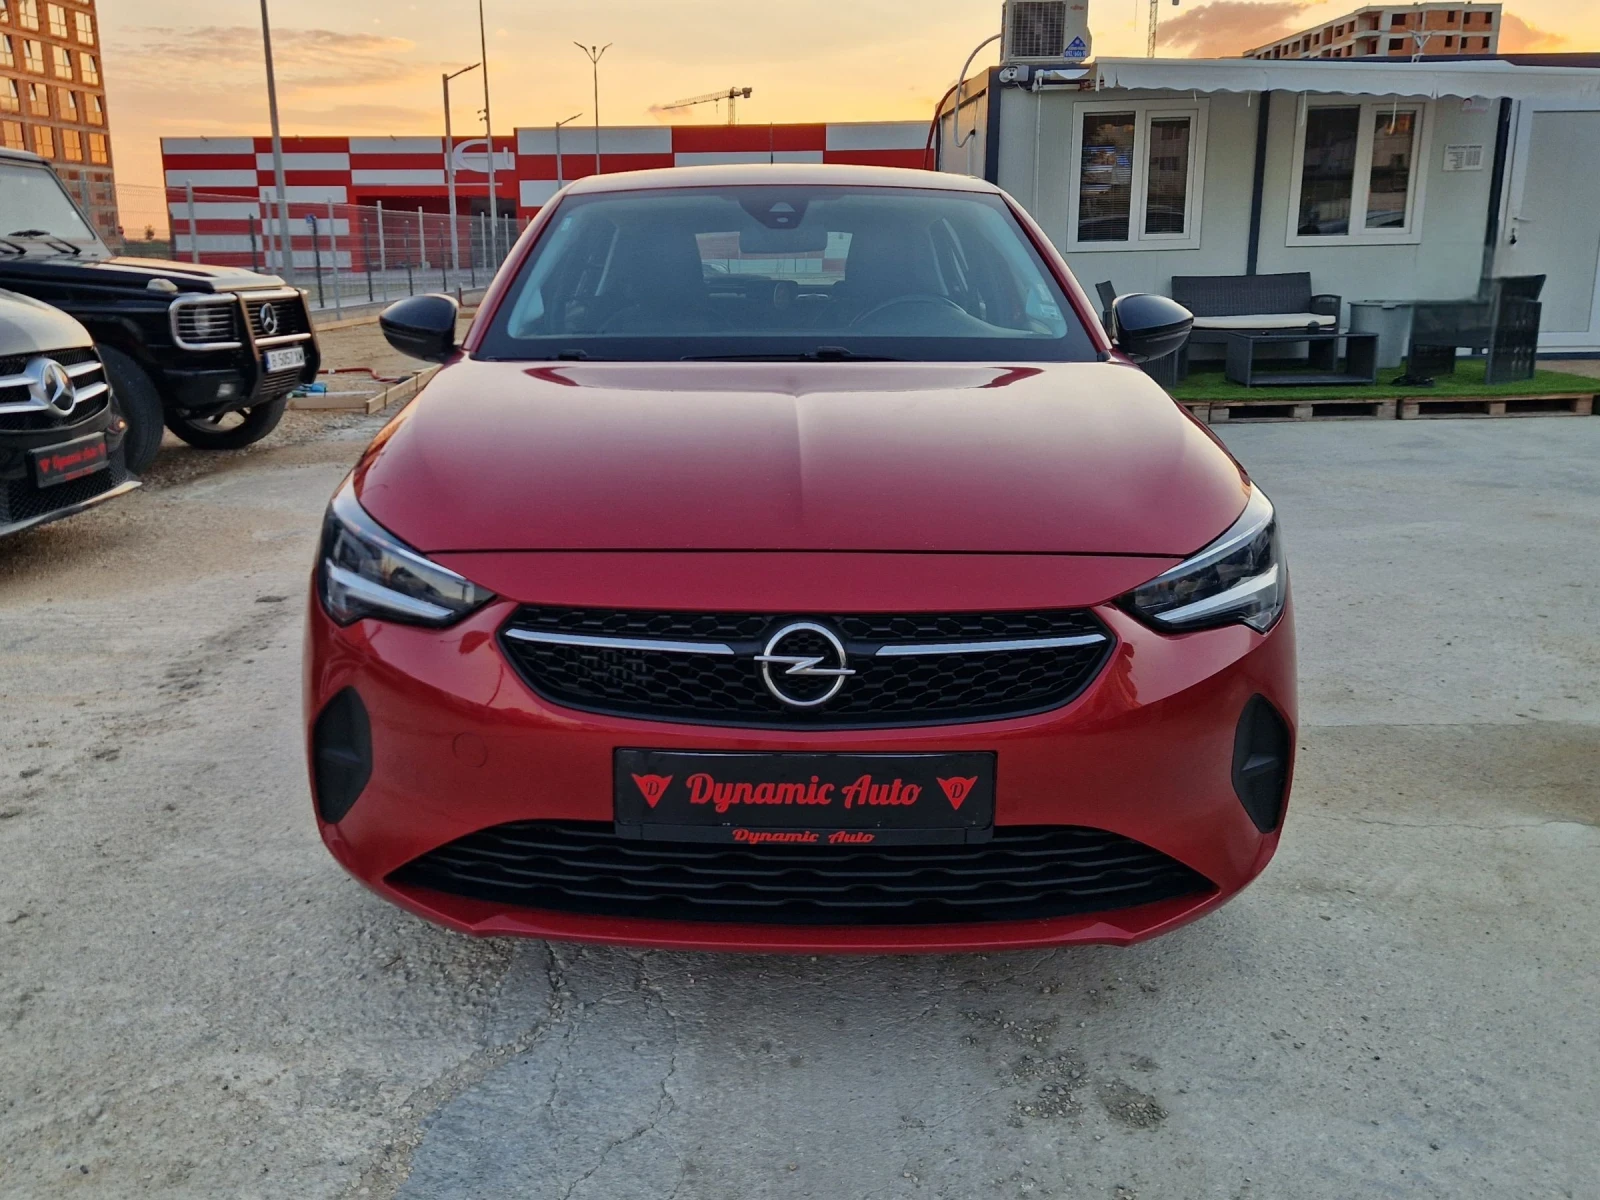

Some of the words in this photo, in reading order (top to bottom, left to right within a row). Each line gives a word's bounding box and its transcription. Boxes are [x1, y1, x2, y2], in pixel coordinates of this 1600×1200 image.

[686, 773, 835, 813] Dynamic
[842, 774, 922, 808] Auto
[732, 829, 819, 845] Dynamic
[828, 831, 875, 844] Auto
